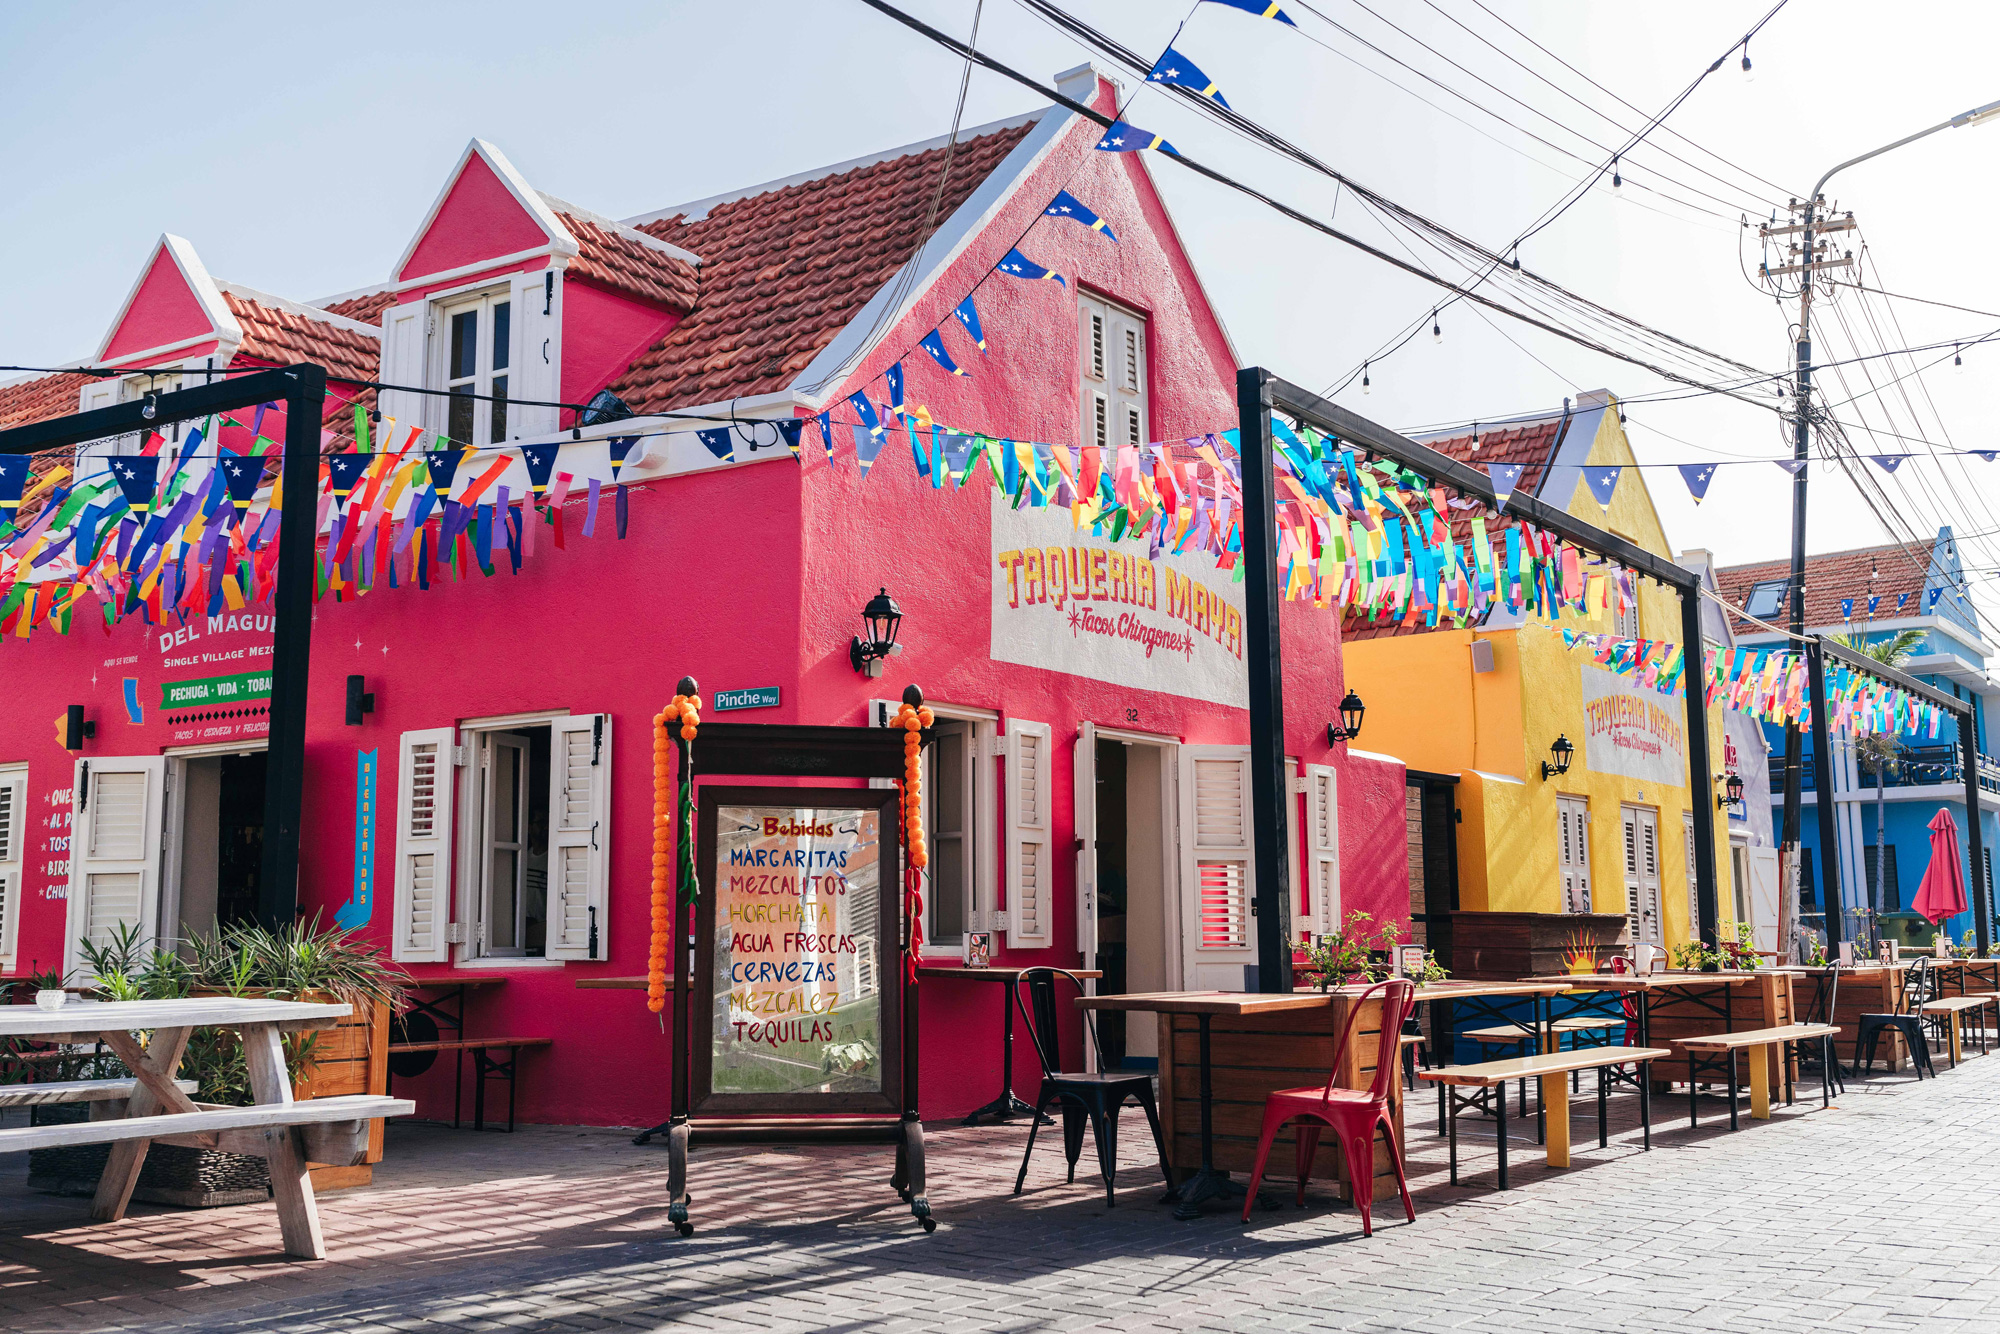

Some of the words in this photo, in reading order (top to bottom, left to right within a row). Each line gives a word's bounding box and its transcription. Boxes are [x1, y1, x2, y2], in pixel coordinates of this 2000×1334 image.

[998, 546, 1157, 612] TAQUERIA
[1165, 565, 1242, 661] MAYA
[159, 625, 200, 654] DEL
[1080, 607, 1116, 637] Tacos
[1117, 612, 1184, 659] Chingones
[116, 657, 122, 665] SE
[123, 655, 138, 664] VENDE
[164, 656, 199, 668] SINGLE
[170, 685, 209, 701] PECHUGA
[217, 682, 238, 696] VIDA
[717, 691, 760, 707] Pinche
[762, 695, 776, 704] Way
[1126, 708, 1138, 722] 32
[174, 729, 194, 740] TACOS
[197, 729, 202, 738] Y
[203, 726, 232, 737] CERVEZA
[235, 725, 241, 734] Y
[1586, 694, 1646, 737] TAQUERIA
[1648, 700, 1682, 757] MAYA
[49, 813, 62, 829] AL
[762, 817, 834, 838] Bebidas
[360, 763, 371, 905] BIENVENIDOS
[730, 849, 848, 868] MARGARITAS
[729, 902, 831, 923] HORCHATA
[730, 932, 774, 953] AGUA
